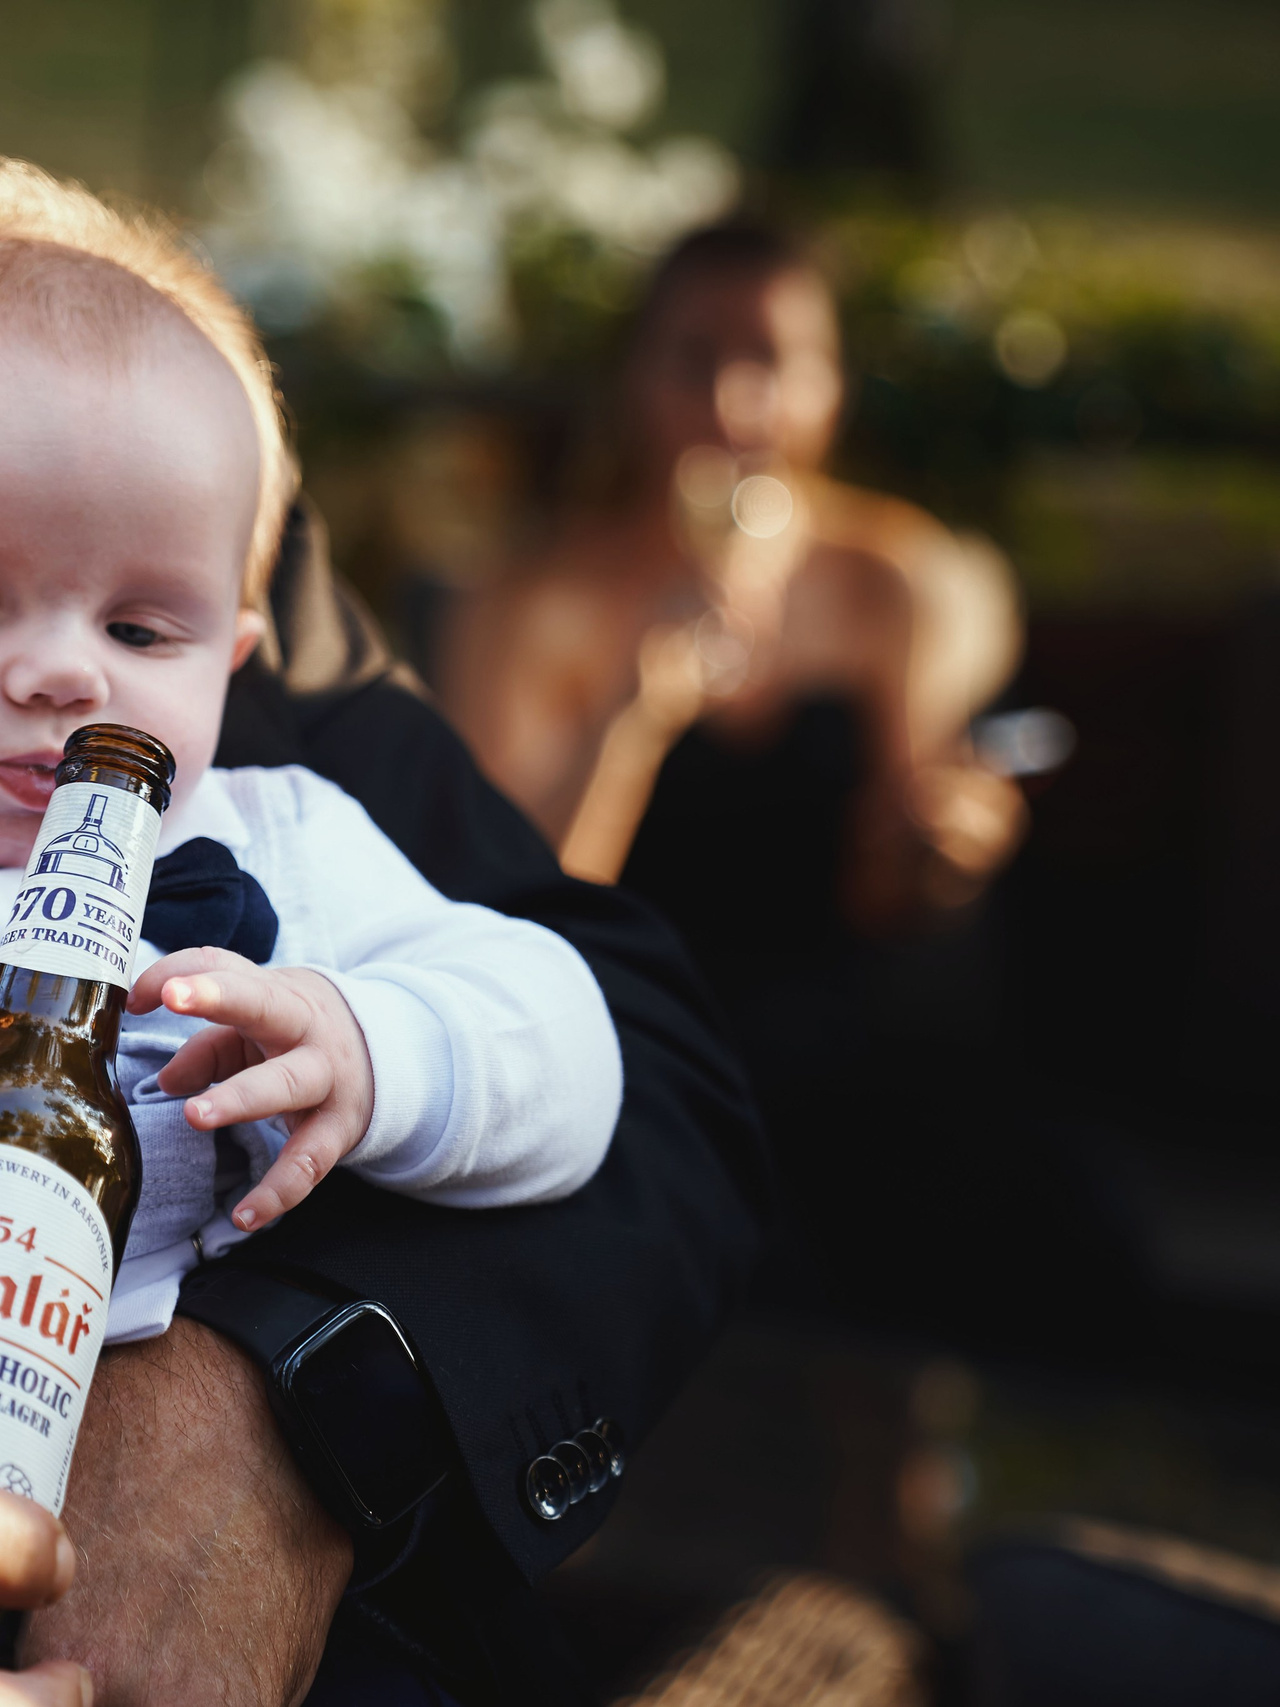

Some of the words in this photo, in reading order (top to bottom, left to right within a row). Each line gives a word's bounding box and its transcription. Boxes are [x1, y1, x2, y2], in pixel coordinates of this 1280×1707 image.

[83, 903, 133, 942] YEARS
[0, 928, 27, 946] EER
[31, 927, 127, 974] TRADITION
[53, 1182, 70, 1200] IN
